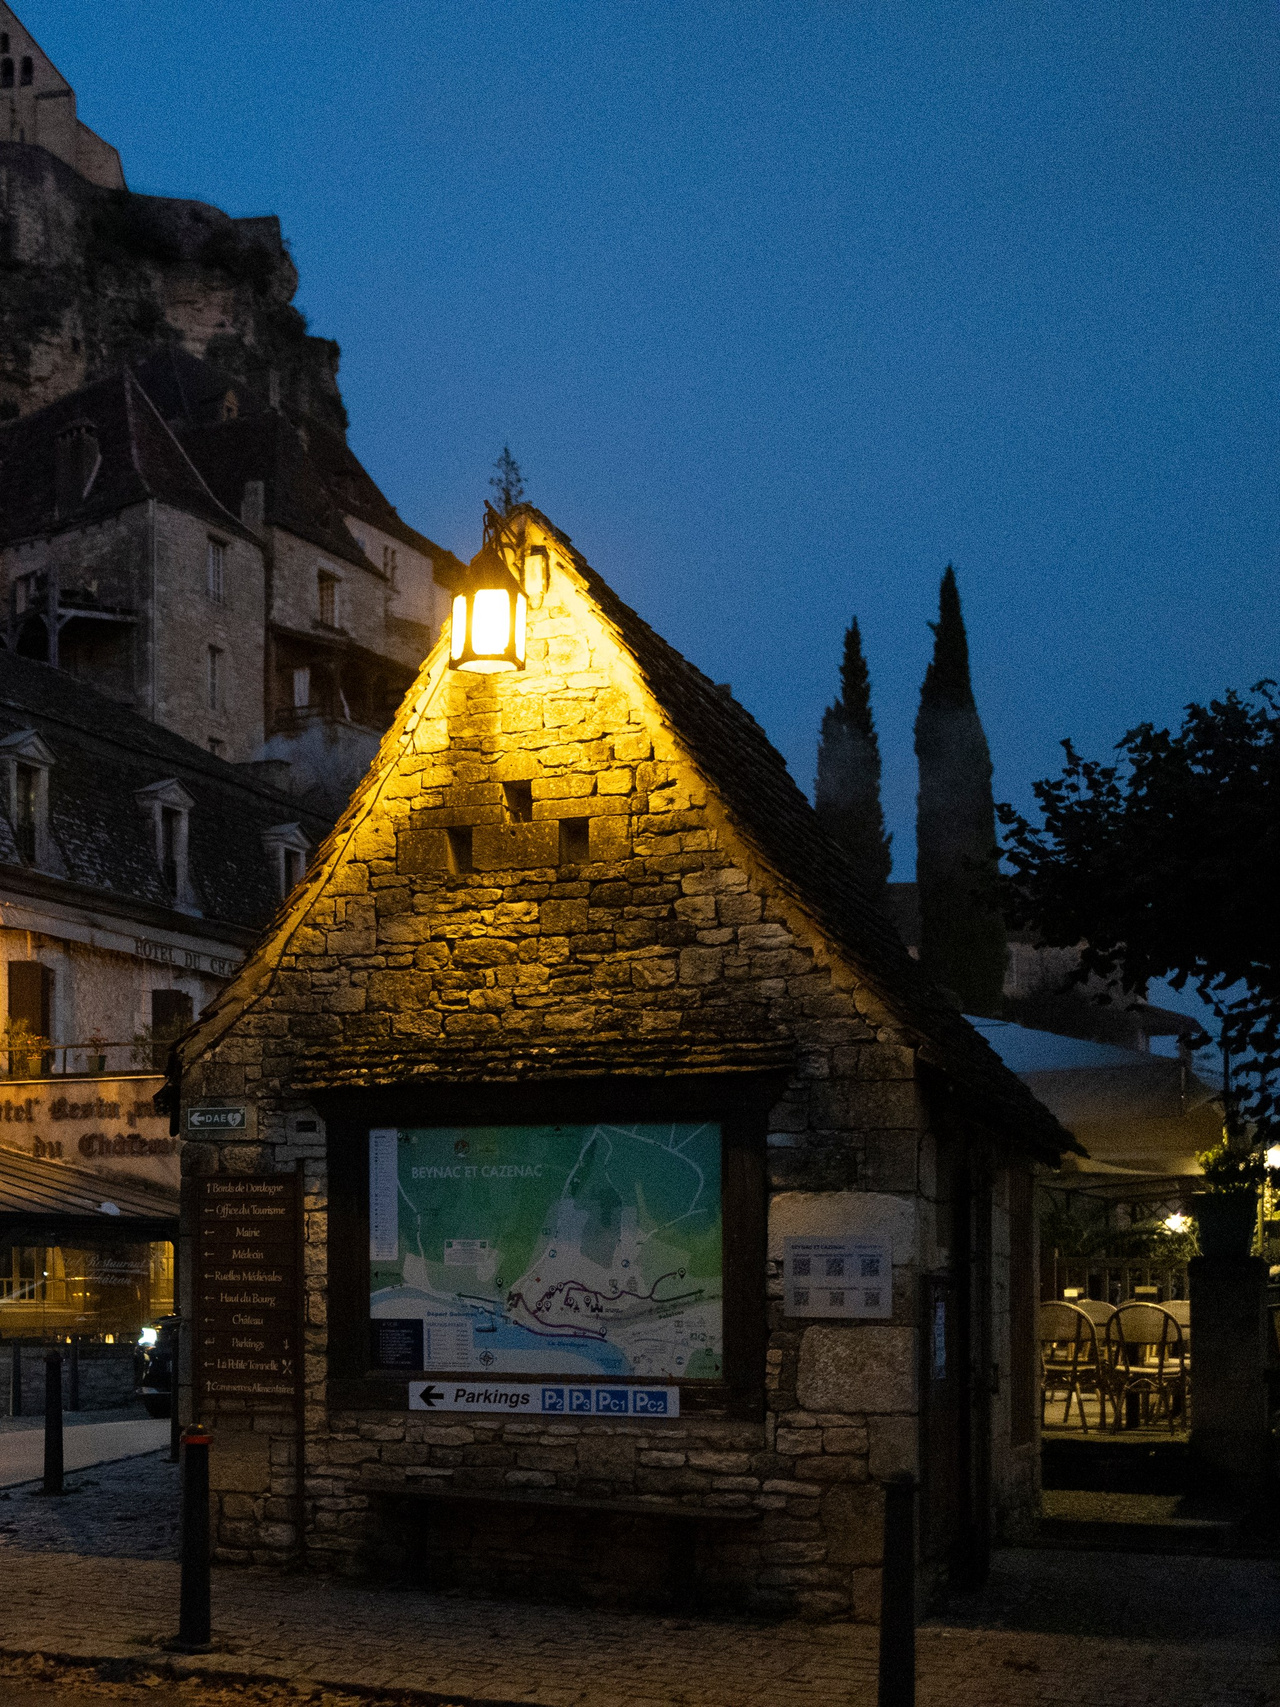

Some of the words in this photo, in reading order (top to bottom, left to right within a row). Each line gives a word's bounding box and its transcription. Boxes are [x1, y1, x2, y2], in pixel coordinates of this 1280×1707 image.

[135, 938, 176, 963] HOTEL
[184, 952, 201, 969] DU
[205, 1114, 227, 1122] DAE
[33, 1134, 63, 1158] du
[411, 1166, 461, 1179] BEYNAC
[465, 1166, 477, 1177] ET
[481, 1164, 543, 1177] CAZENAC
[212, 1182, 235, 1193] Bords
[235, 1182, 245, 1192] de
[246, 1182, 284, 1195] Dordogne
[216, 1203, 239, 1218] Office
[239, 1203, 250, 1214] du
[250, 1205, 286, 1215] Tourisme
[235, 1227, 260, 1237] Mairie
[232, 1248, 264, 1259] Médecin
[215, 1270, 240, 1281] Ruelles
[242, 1270, 282, 1282] Médiévales
[220, 1292, 239, 1303] Haut
[240, 1292, 251, 1303] du
[252, 1293, 276, 1307] Bourg
[232, 1314, 263, 1325] Château
[231, 1337, 265, 1351] Parkings
[217, 1359, 227, 1369] La
[228, 1359, 248, 1370] Petite
[248, 1360, 278, 1371] Tonnelle
[211, 1382, 252, 1392] Commerces
[252, 1383, 295, 1395] Alimentaires
[453, 1388, 530, 1408] Parkings
[543, 1390, 564, 1410] P2
[571, 1391, 591, 1411] P3
